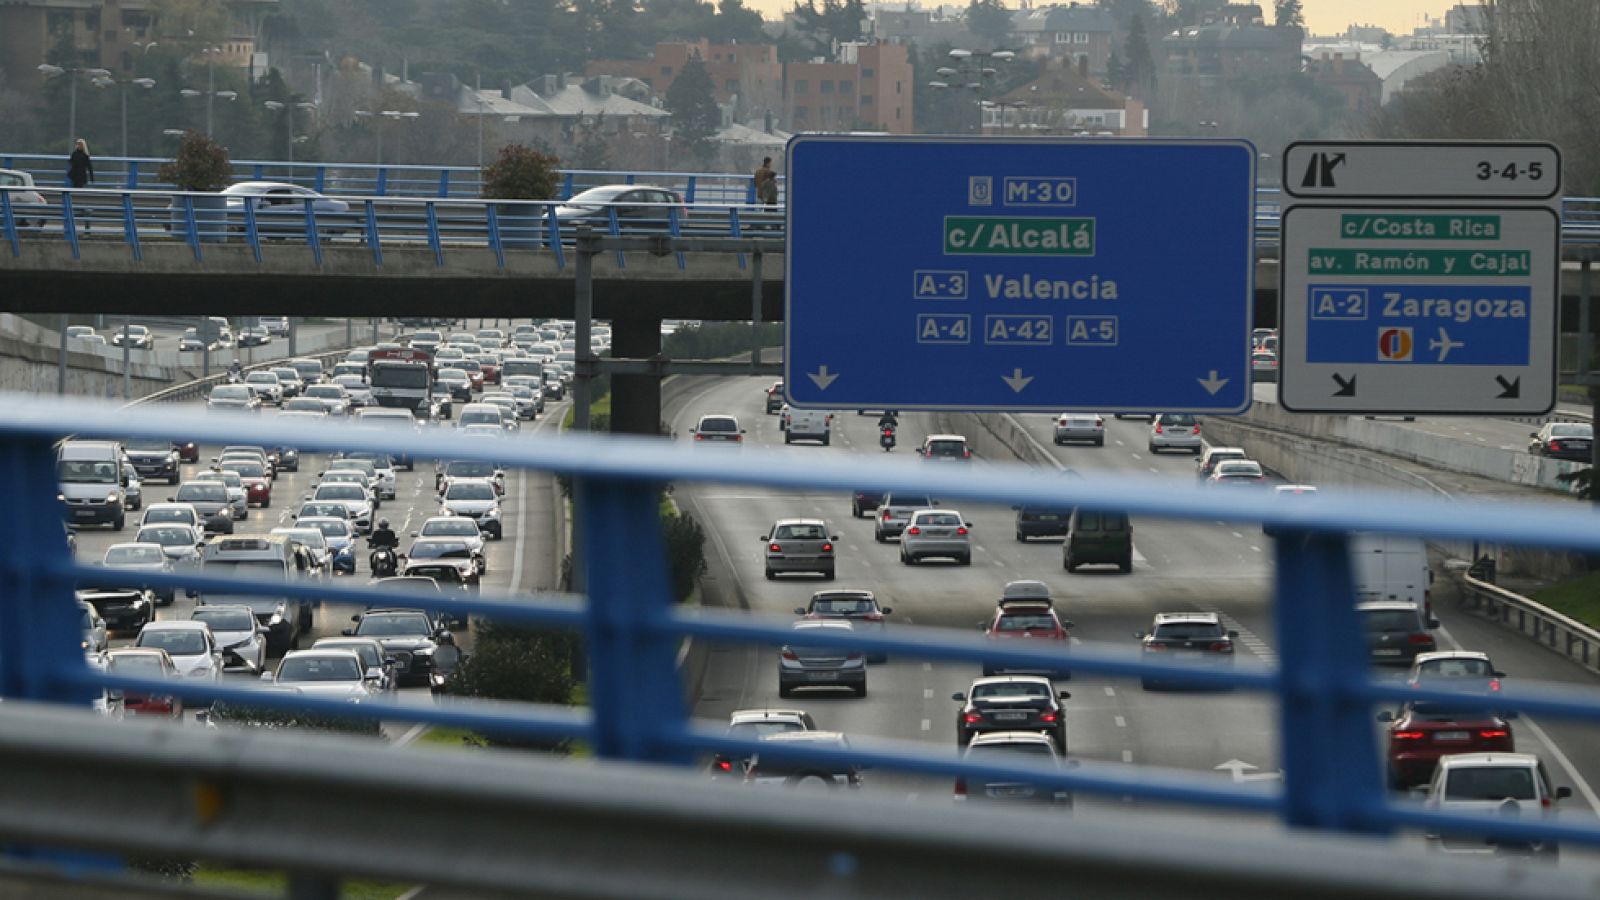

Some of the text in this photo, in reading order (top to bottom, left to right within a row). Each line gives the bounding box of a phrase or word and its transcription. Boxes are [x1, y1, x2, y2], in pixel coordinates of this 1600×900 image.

[1476, 161, 1543, 181] 3-4-5
[1008, 182, 1072, 202] M-30
[949, 223, 1090, 248] c/Alcalá
[1345, 218, 1496, 237] c/Costa Rica
[1311, 252, 1528, 274] av. Ramón y Cajal
[919, 273, 1118, 299] A-3 Valencia
[1318, 293, 1526, 321] A-2 Zaragoza
[922, 319, 1114, 340] A-4 A-42 A-5
